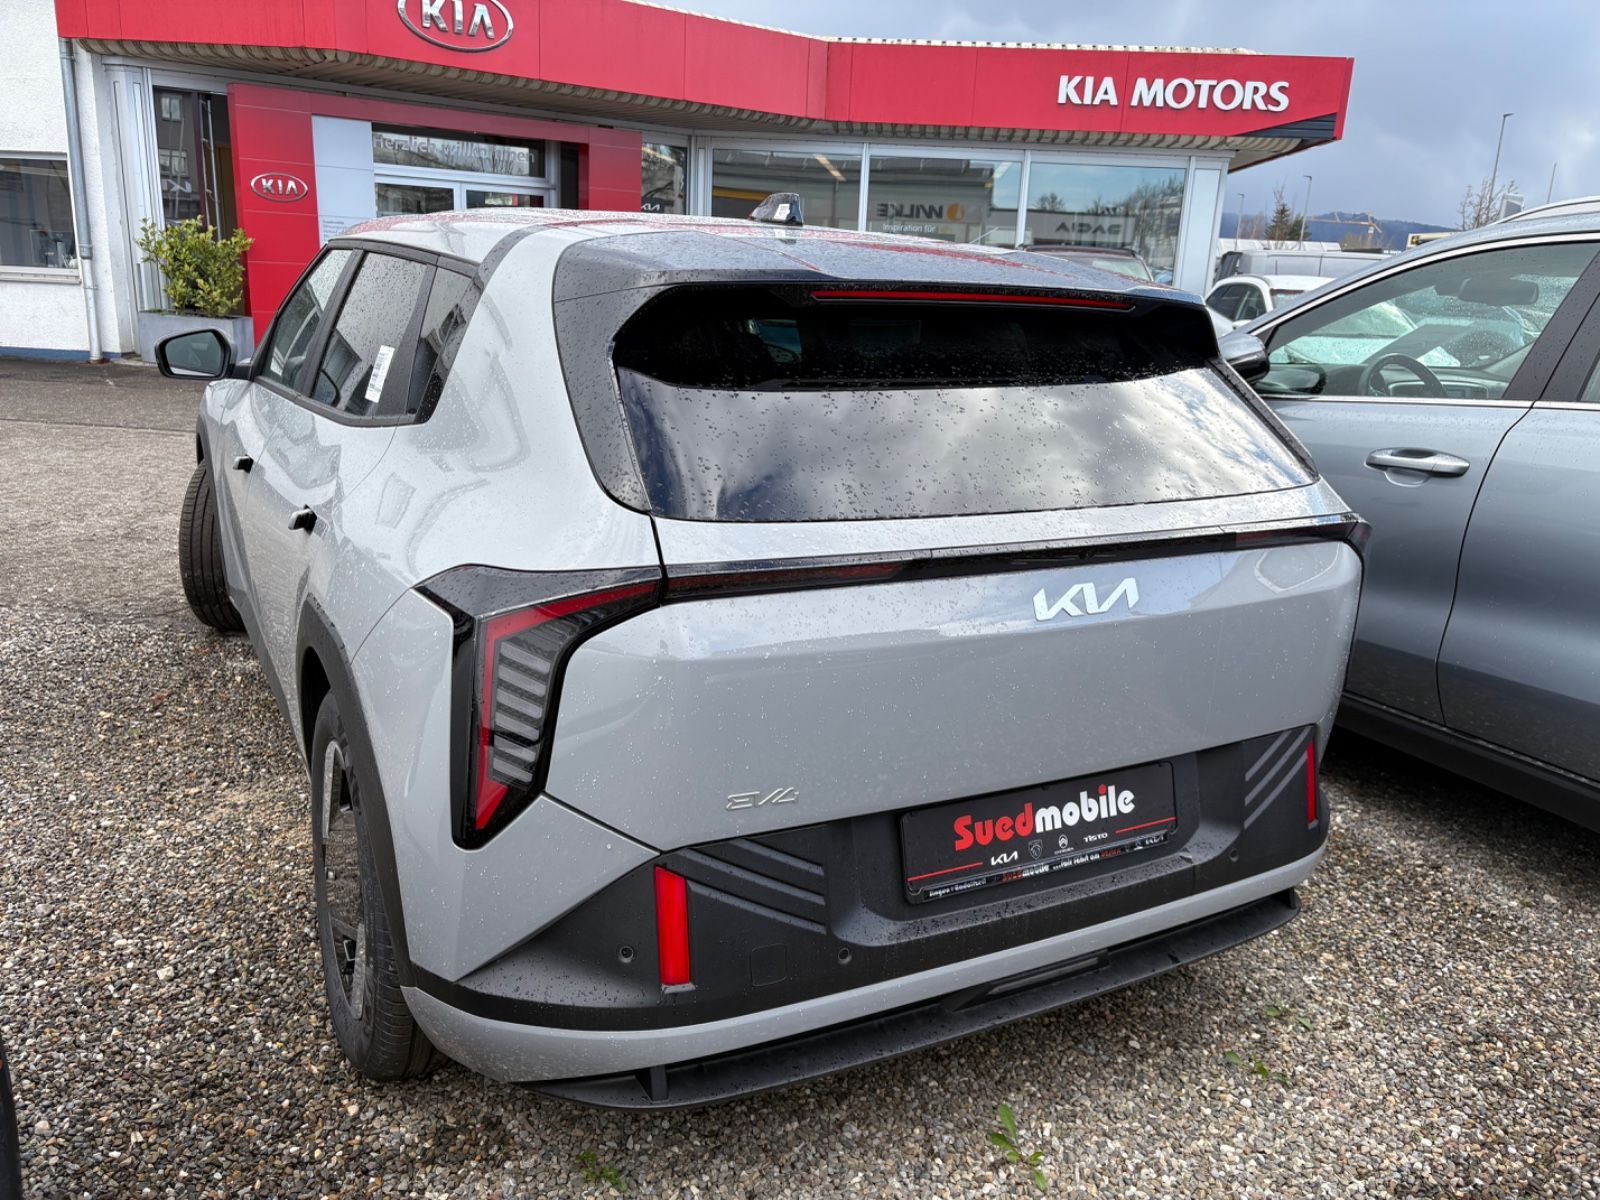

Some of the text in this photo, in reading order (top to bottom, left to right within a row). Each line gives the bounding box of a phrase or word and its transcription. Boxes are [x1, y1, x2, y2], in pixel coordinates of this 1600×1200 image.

[421, 0, 495, 39] KIA
[1057, 75, 1290, 112] KIA MOTORS
[373, 132, 437, 153] Herzlich
[261, 178, 299, 196] KIA
[1033, 577, 1139, 621] KIA
[726, 786, 799, 811] EV4
[953, 783, 1136, 851] Suedmobile
[990, 850, 1019, 866] KIA
